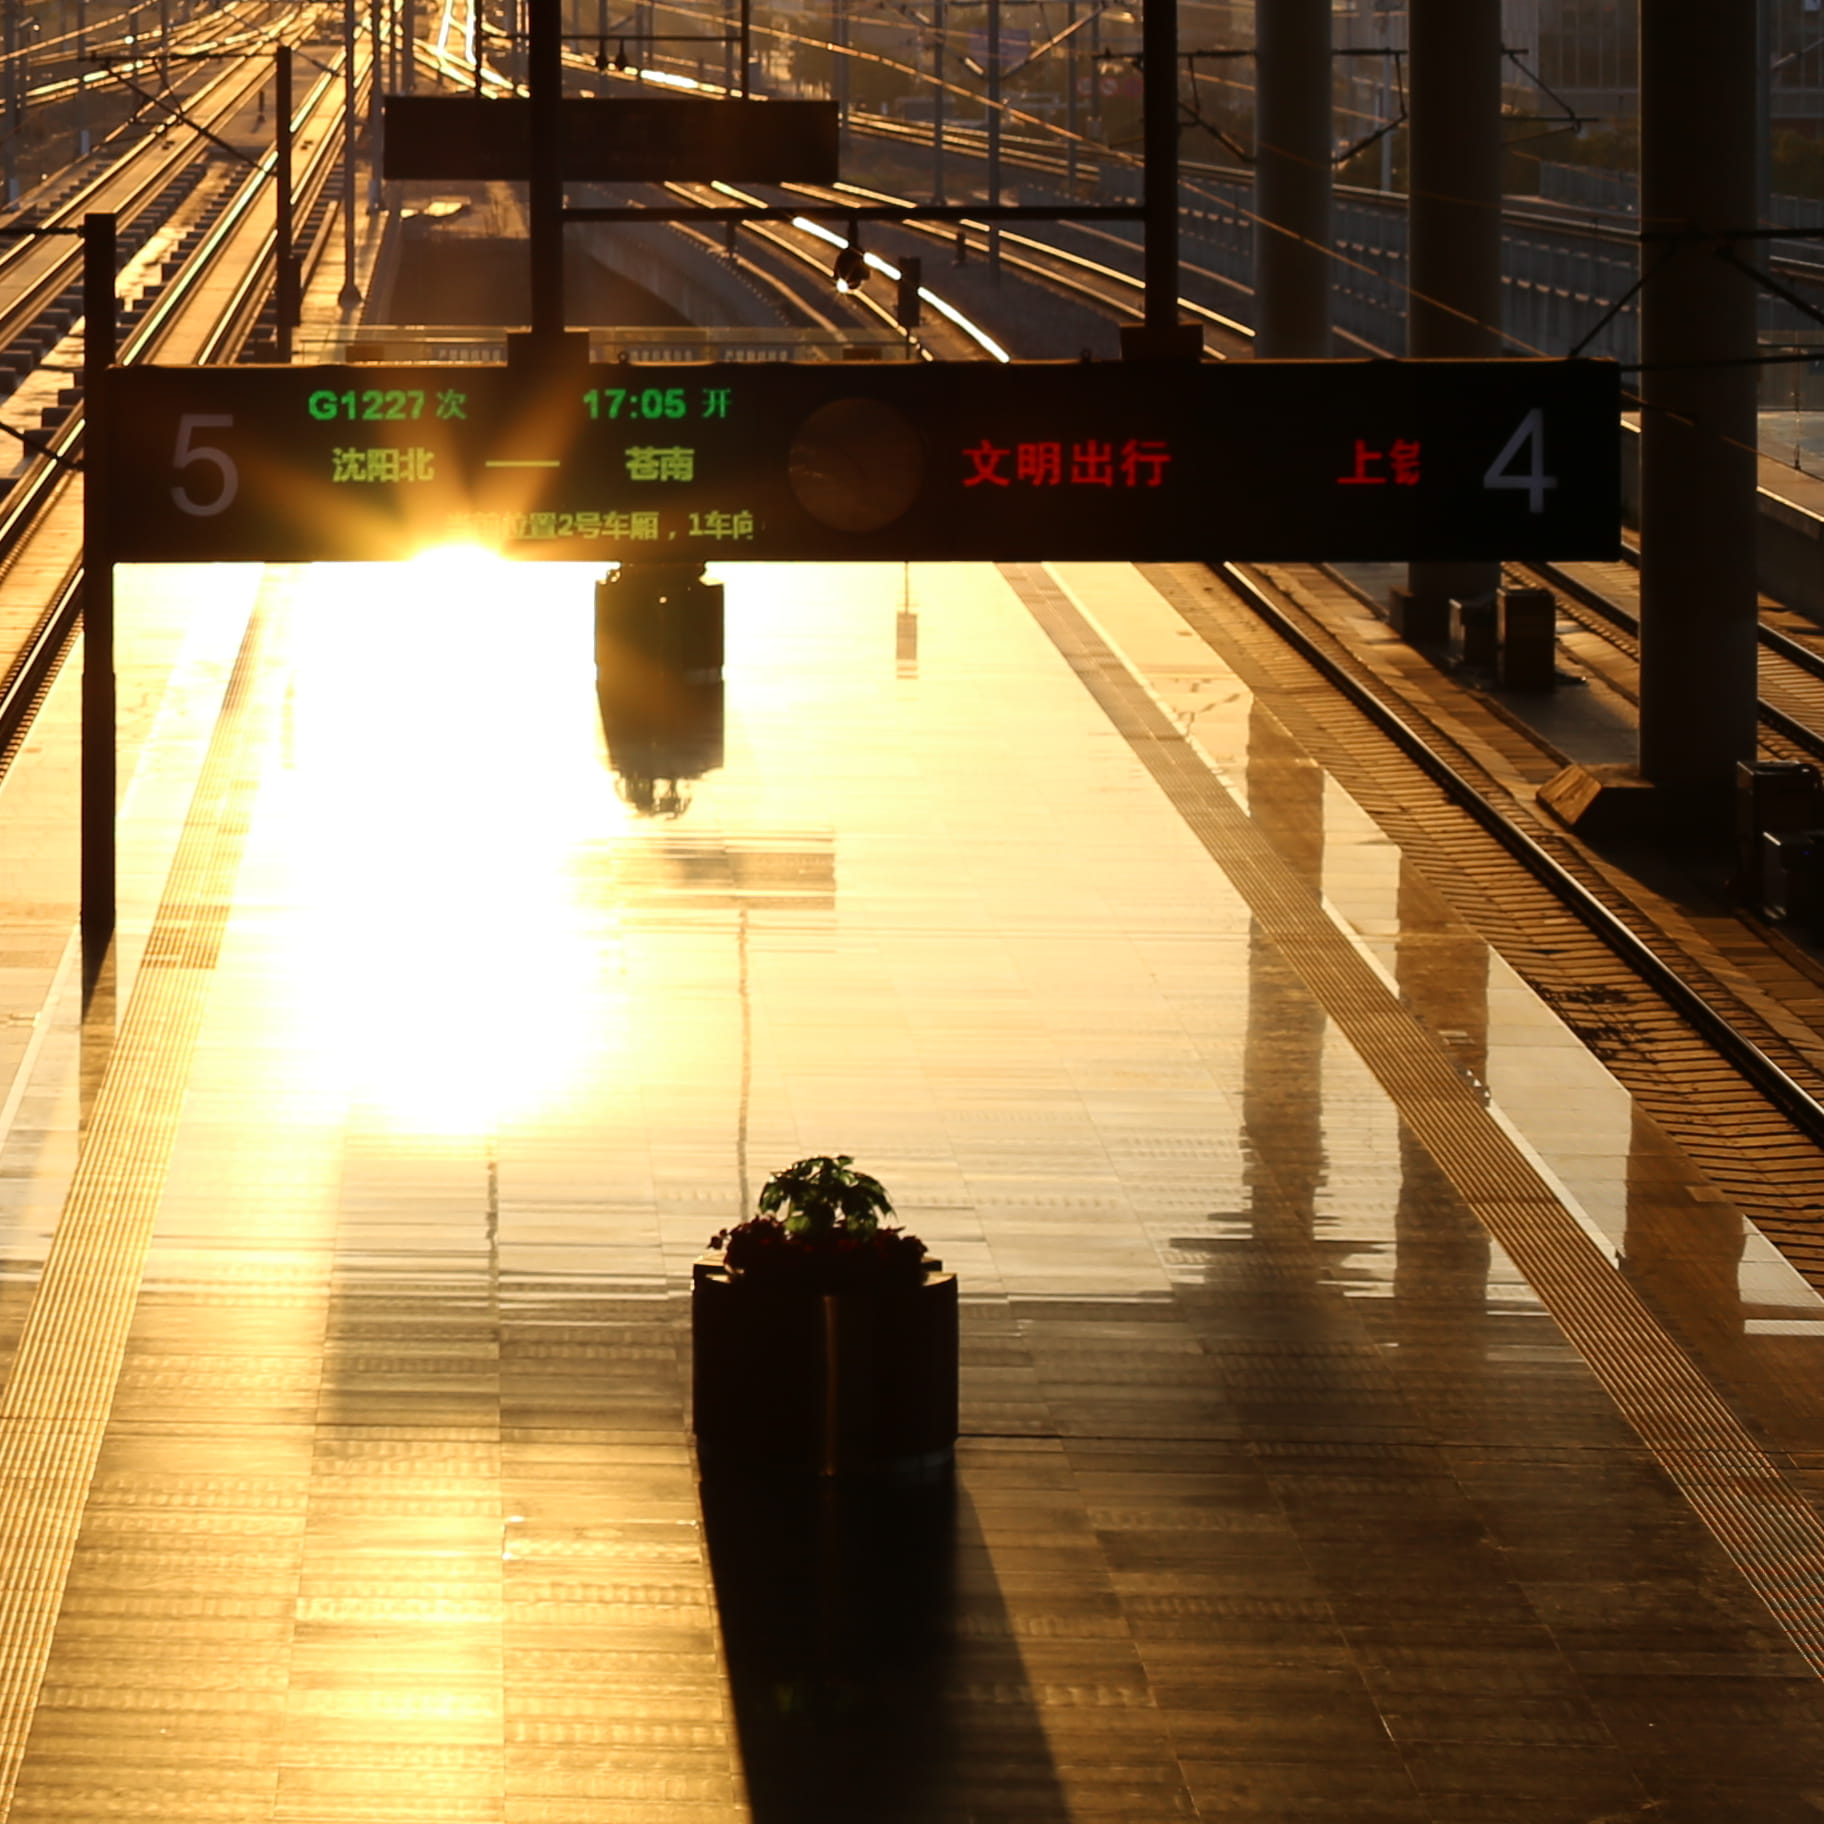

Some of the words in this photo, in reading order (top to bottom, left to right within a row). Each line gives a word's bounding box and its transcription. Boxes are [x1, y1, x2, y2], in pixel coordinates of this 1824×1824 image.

[307, 389, 424, 421] G1227
[435, 388, 469, 420] 次
[583, 388, 688, 419] 17:05
[701, 388, 732, 419] 开
[170, 412, 240, 517] 5
[331, 447, 435, 483] 沈阳北
[625, 447, 695, 482] 苍南
[961, 439, 1172, 488] 文明出行
[1482, 407, 1559, 516] 4
